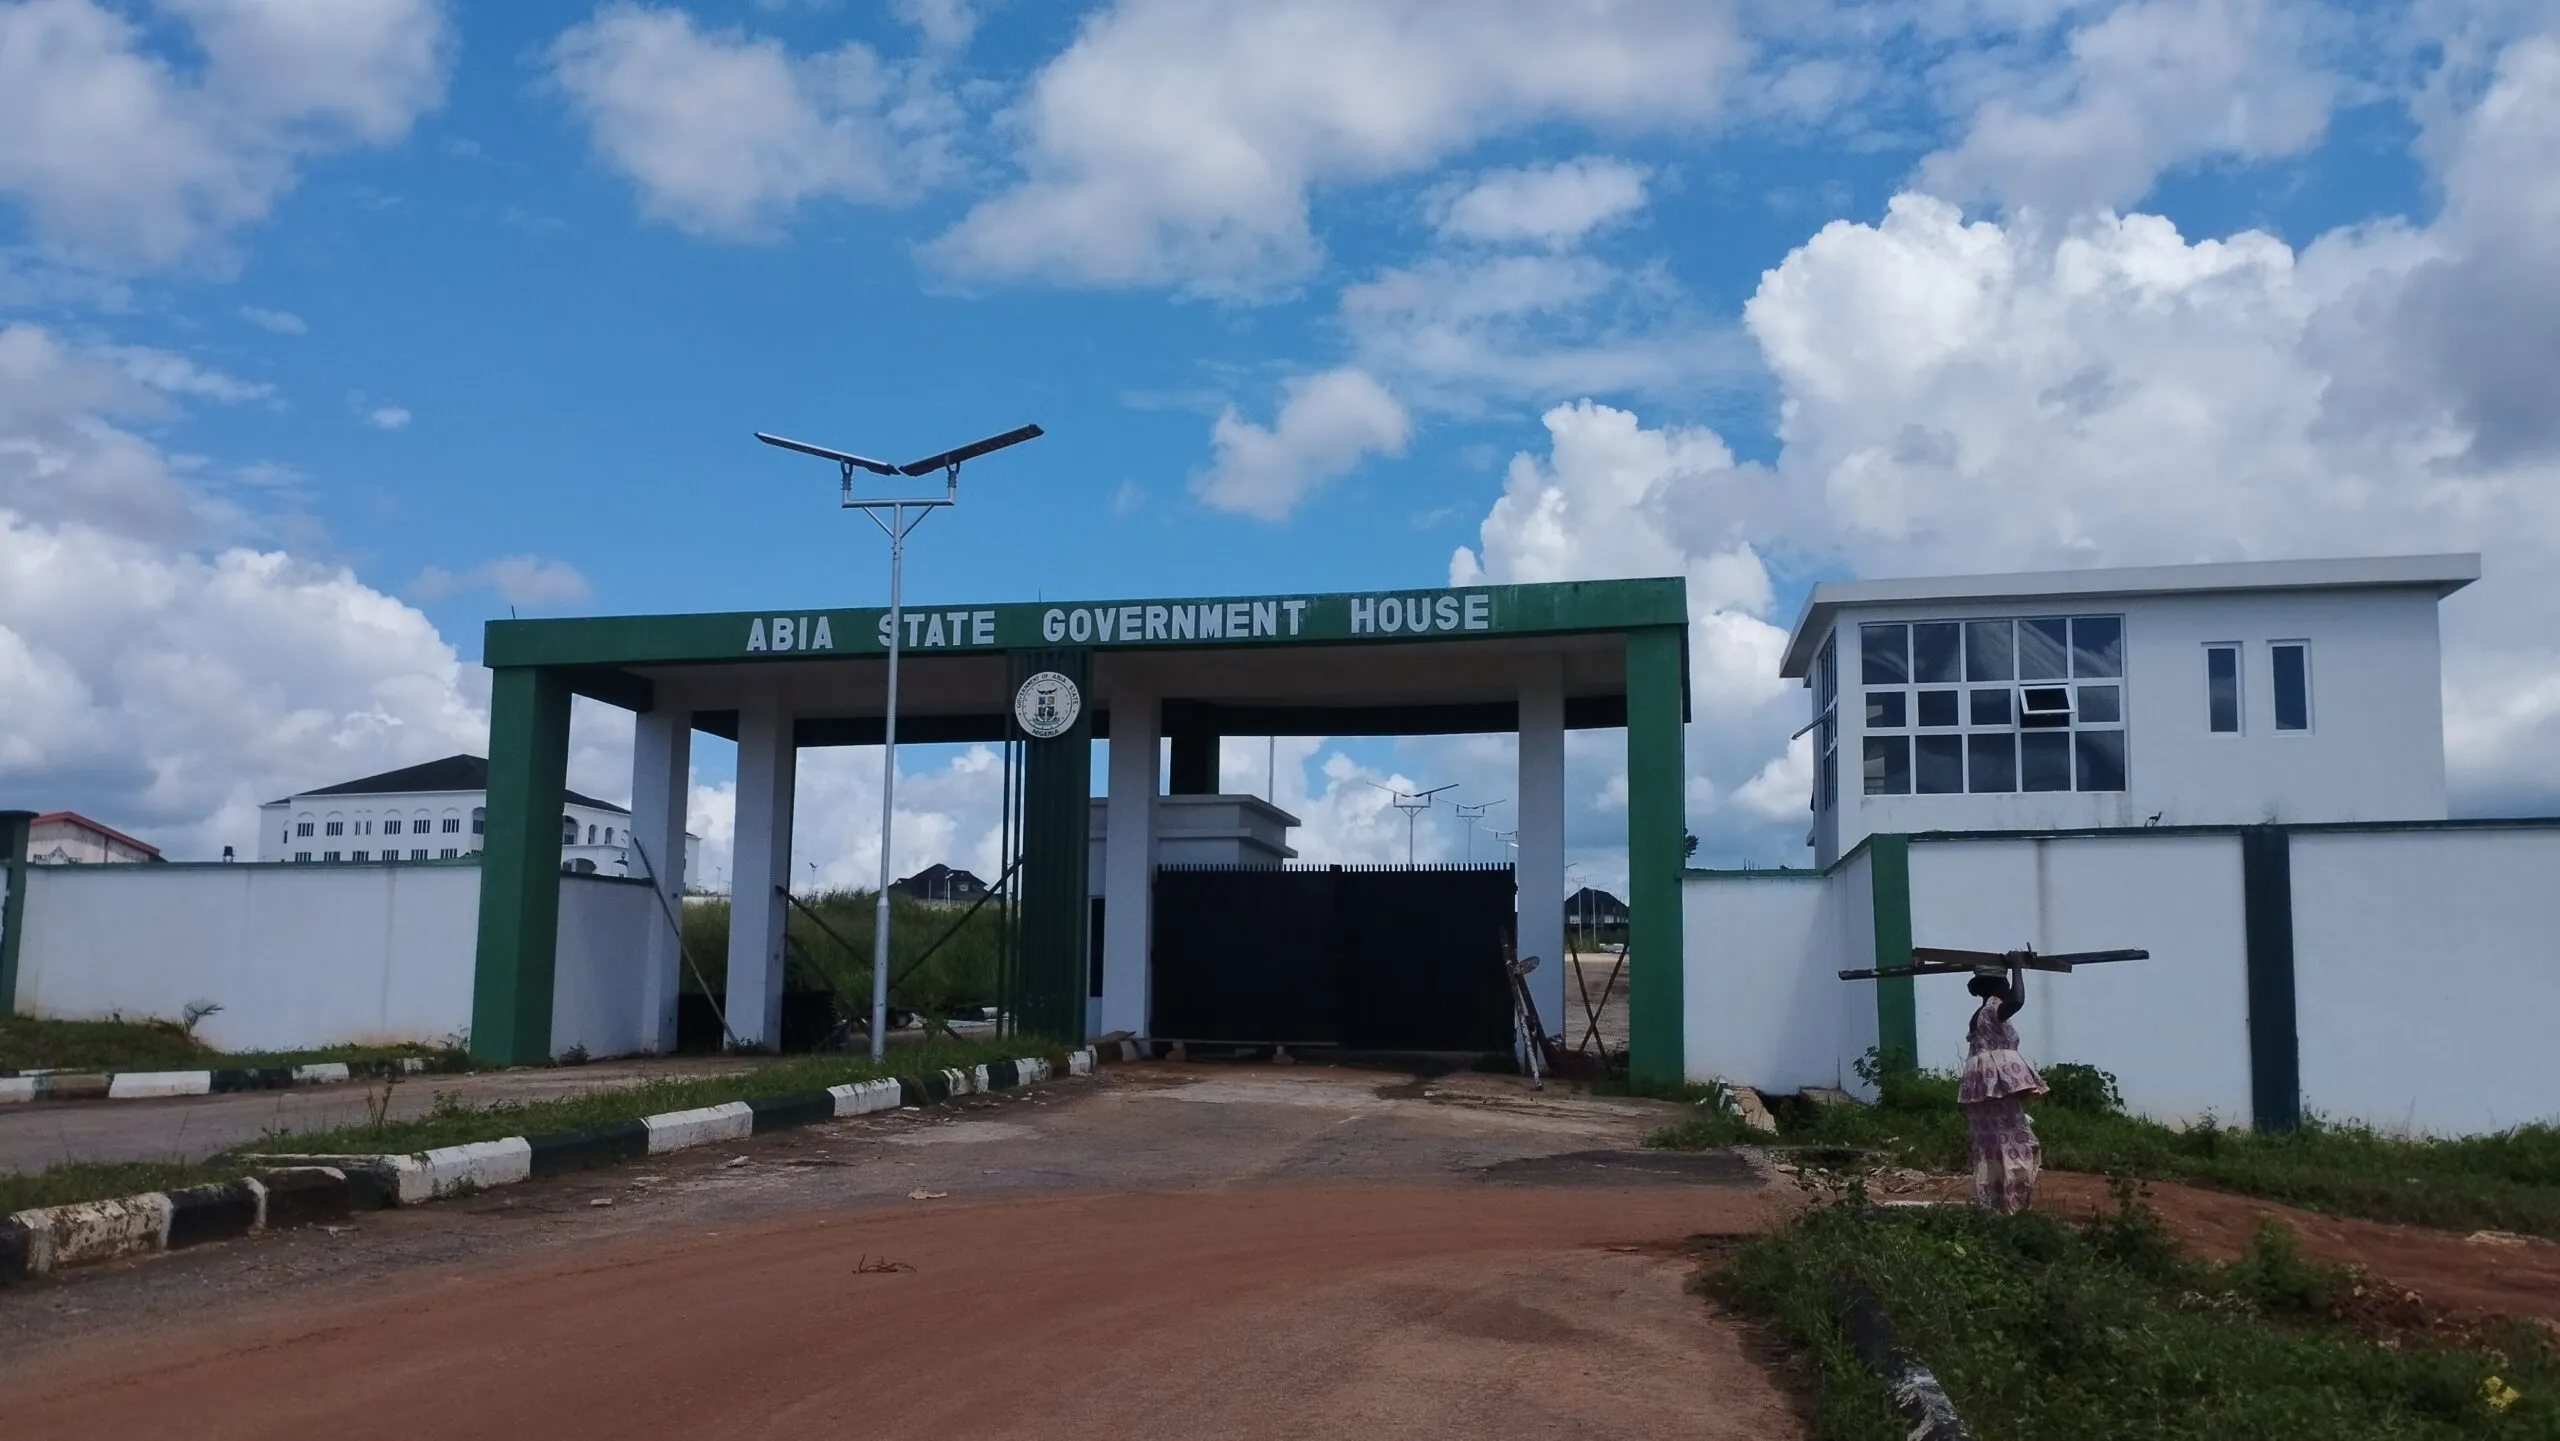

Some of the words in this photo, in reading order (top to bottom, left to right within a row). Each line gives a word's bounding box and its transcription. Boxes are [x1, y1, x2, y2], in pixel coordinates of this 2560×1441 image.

[746, 616, 833, 651] ABIA
[877, 610, 996, 648] STATE
[1042, 600, 1306, 642] GOVERNMENT
[1350, 594, 1490, 634] HOUSE
[1016, 675, 1040, 709] GOVERNMENT
[1052, 674, 1067, 683] ABIA
[1069, 685, 1078, 704] STATE
